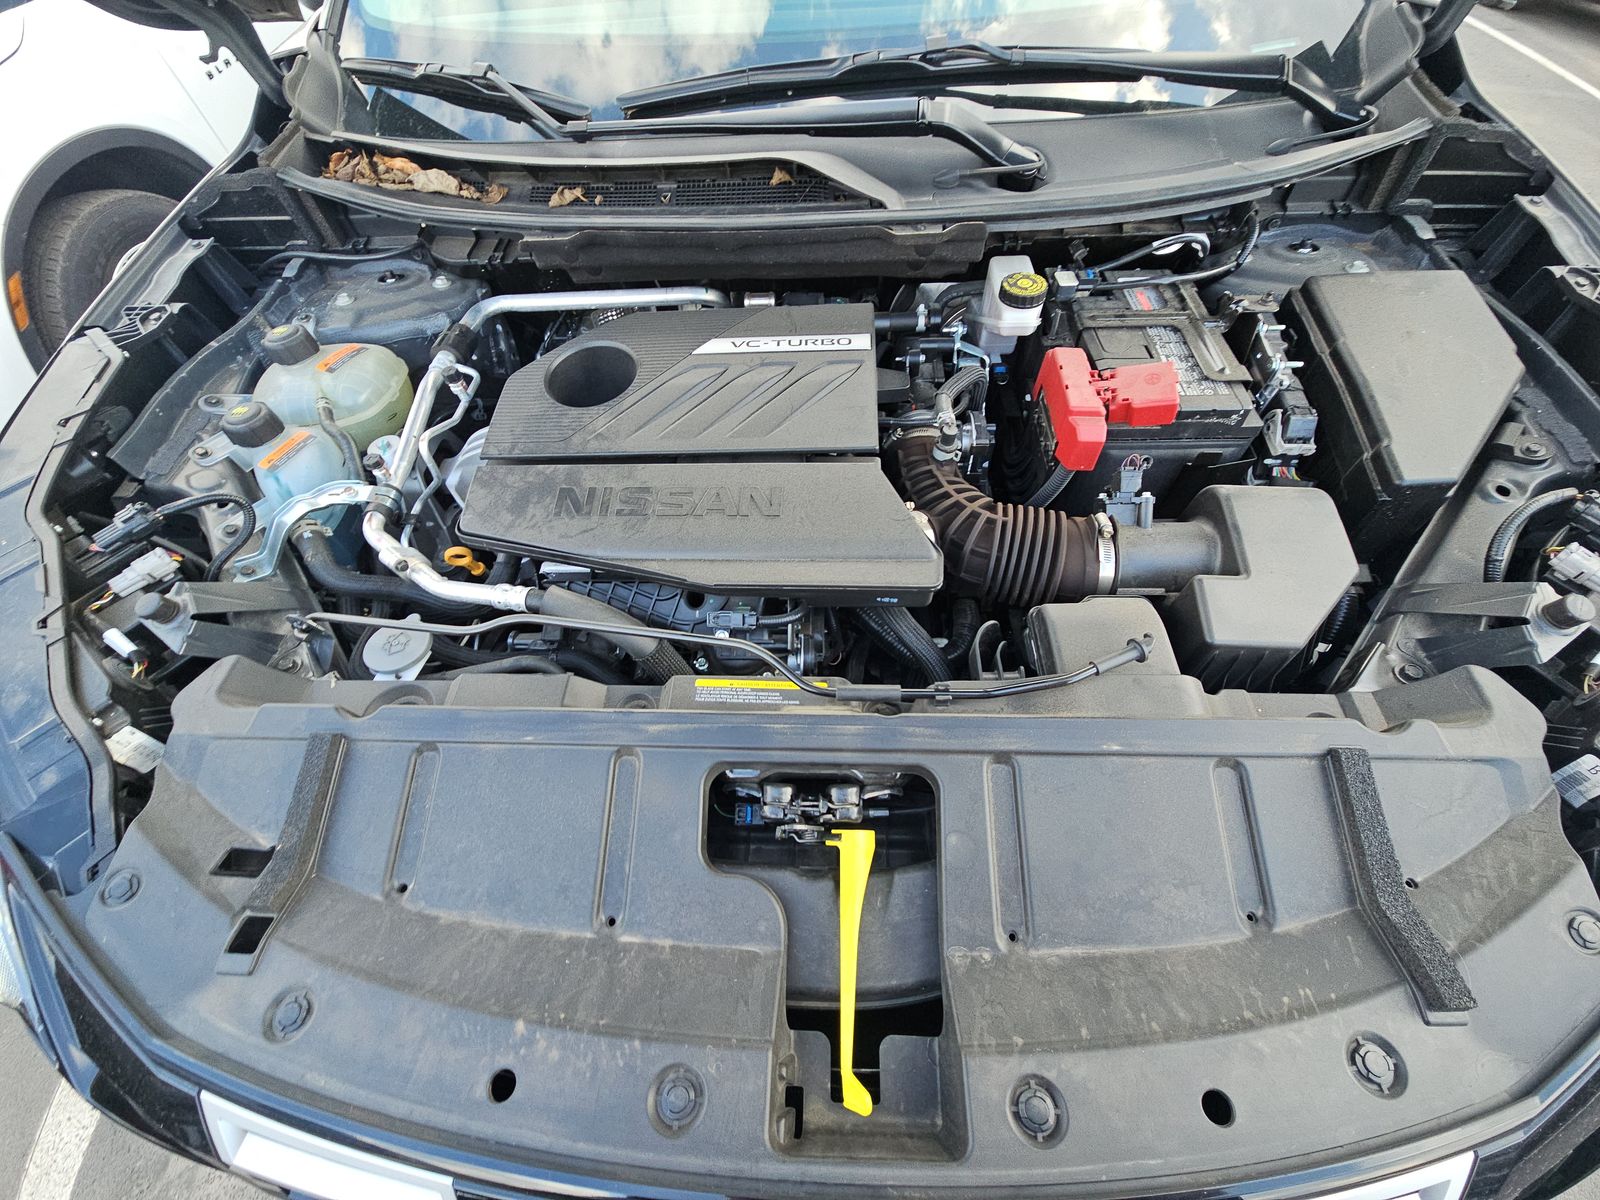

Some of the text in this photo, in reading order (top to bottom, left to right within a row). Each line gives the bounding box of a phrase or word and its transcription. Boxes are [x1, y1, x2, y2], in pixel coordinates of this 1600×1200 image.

[205, 58, 239, 80] BLA
[731, 337, 852, 348] VC-TURBO
[552, 486, 783, 517] NISSAN
